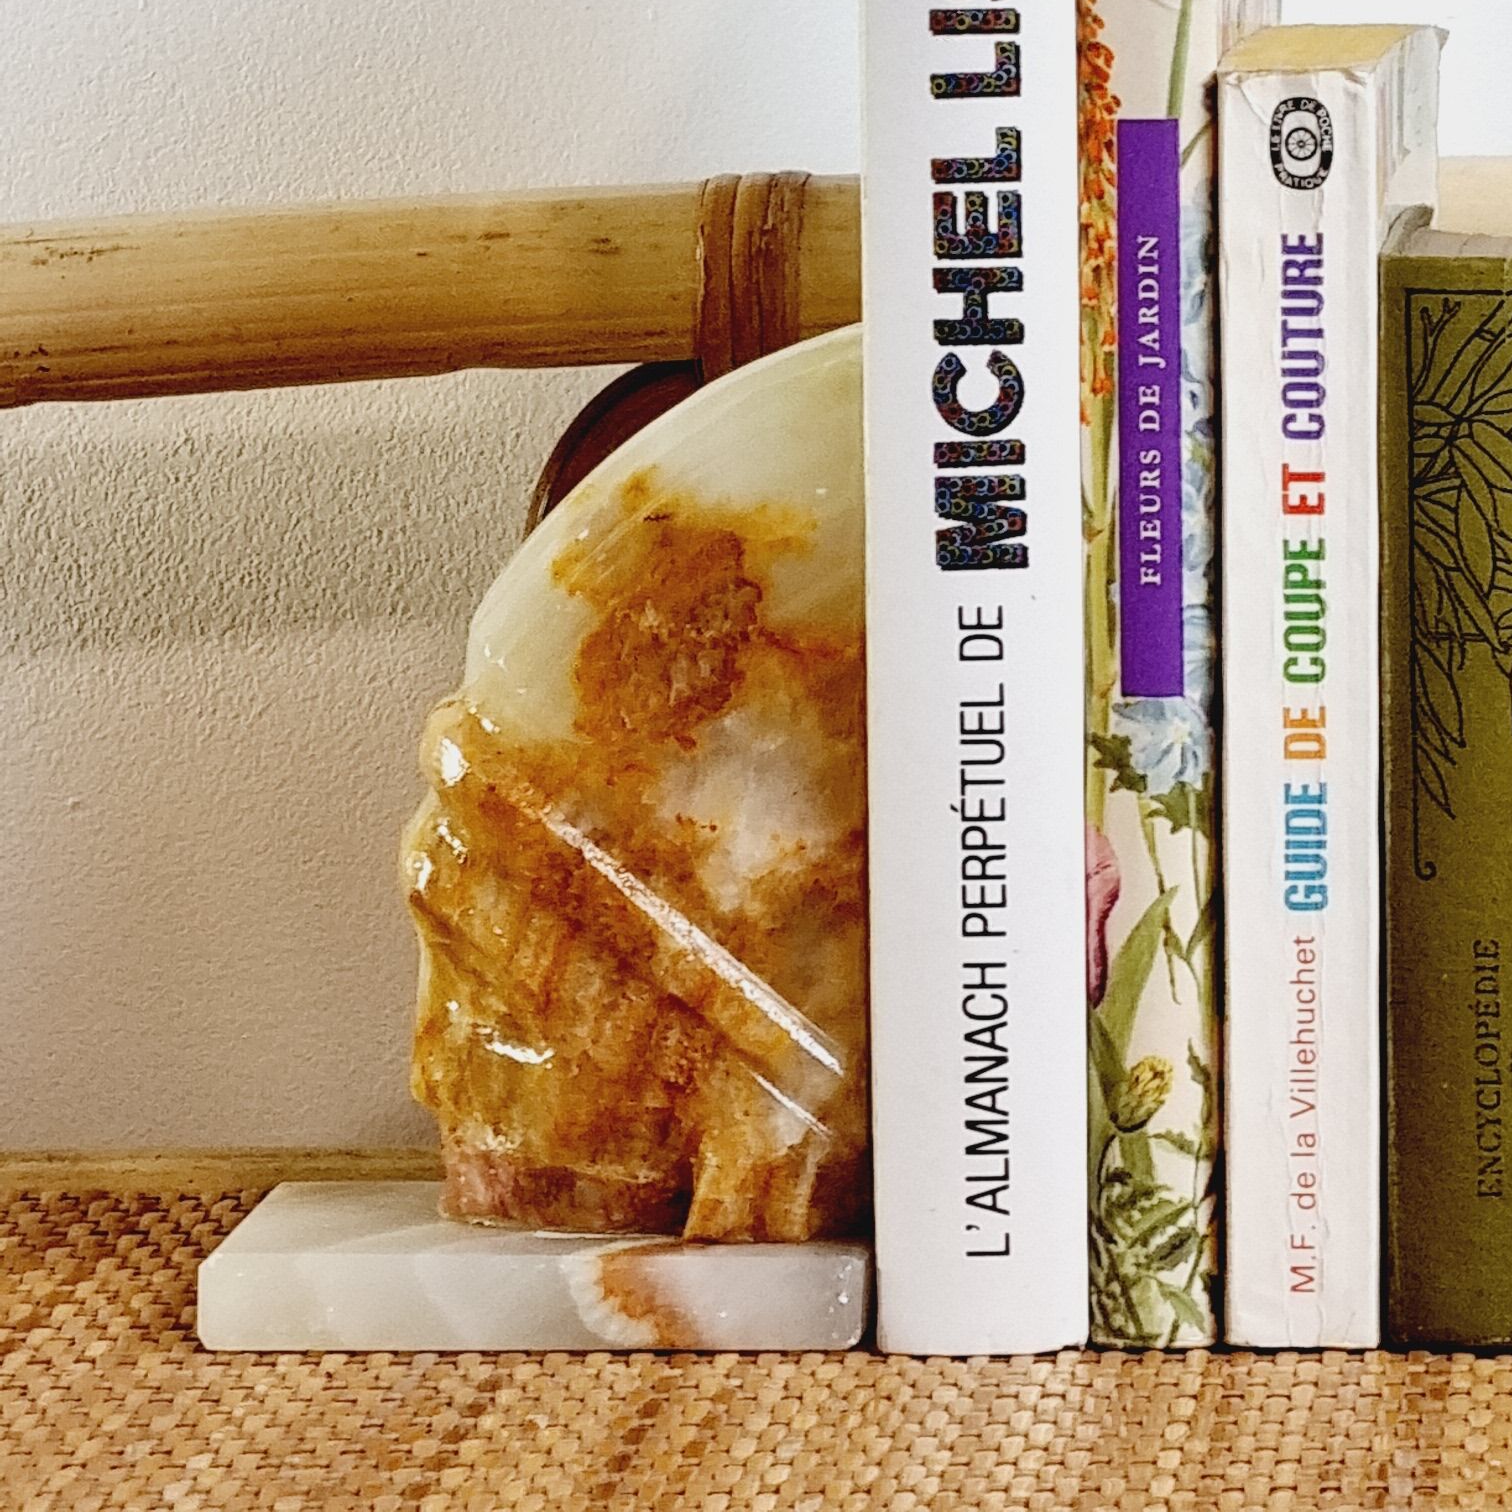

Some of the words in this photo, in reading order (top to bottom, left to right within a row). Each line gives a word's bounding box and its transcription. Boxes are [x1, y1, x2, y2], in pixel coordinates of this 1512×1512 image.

[1317, 109, 1333, 152] POCHE
[929, 125, 1030, 572] MICHEL
[1135, 235, 1167, 370] JARDIN
[1280, 232, 1326, 441] COUTURE
[1137, 384, 1161, 433] DE
[1138, 449, 1162, 586] FLEURS
[1281, 462, 1326, 516] ET
[957, 605, 1004, 662] DE
[1282, 537, 1327, 684] COUPE
[1282, 705, 1327, 761] DE
[950, 682, 1007, 938] PERPÉTUEL
[1284, 782, 1328, 912] GUIDE
[1289, 936, 1317, 1119] Villehuchet
[1467, 939, 1503, 1199] ENCYCLOPÉDIE
[962, 962, 1011, 1257] L'ALMANACH
[1290, 1133, 1317, 1158] la
[1290, 1172, 1317, 1210] de
[1289, 1222, 1316, 1293] M.F.
